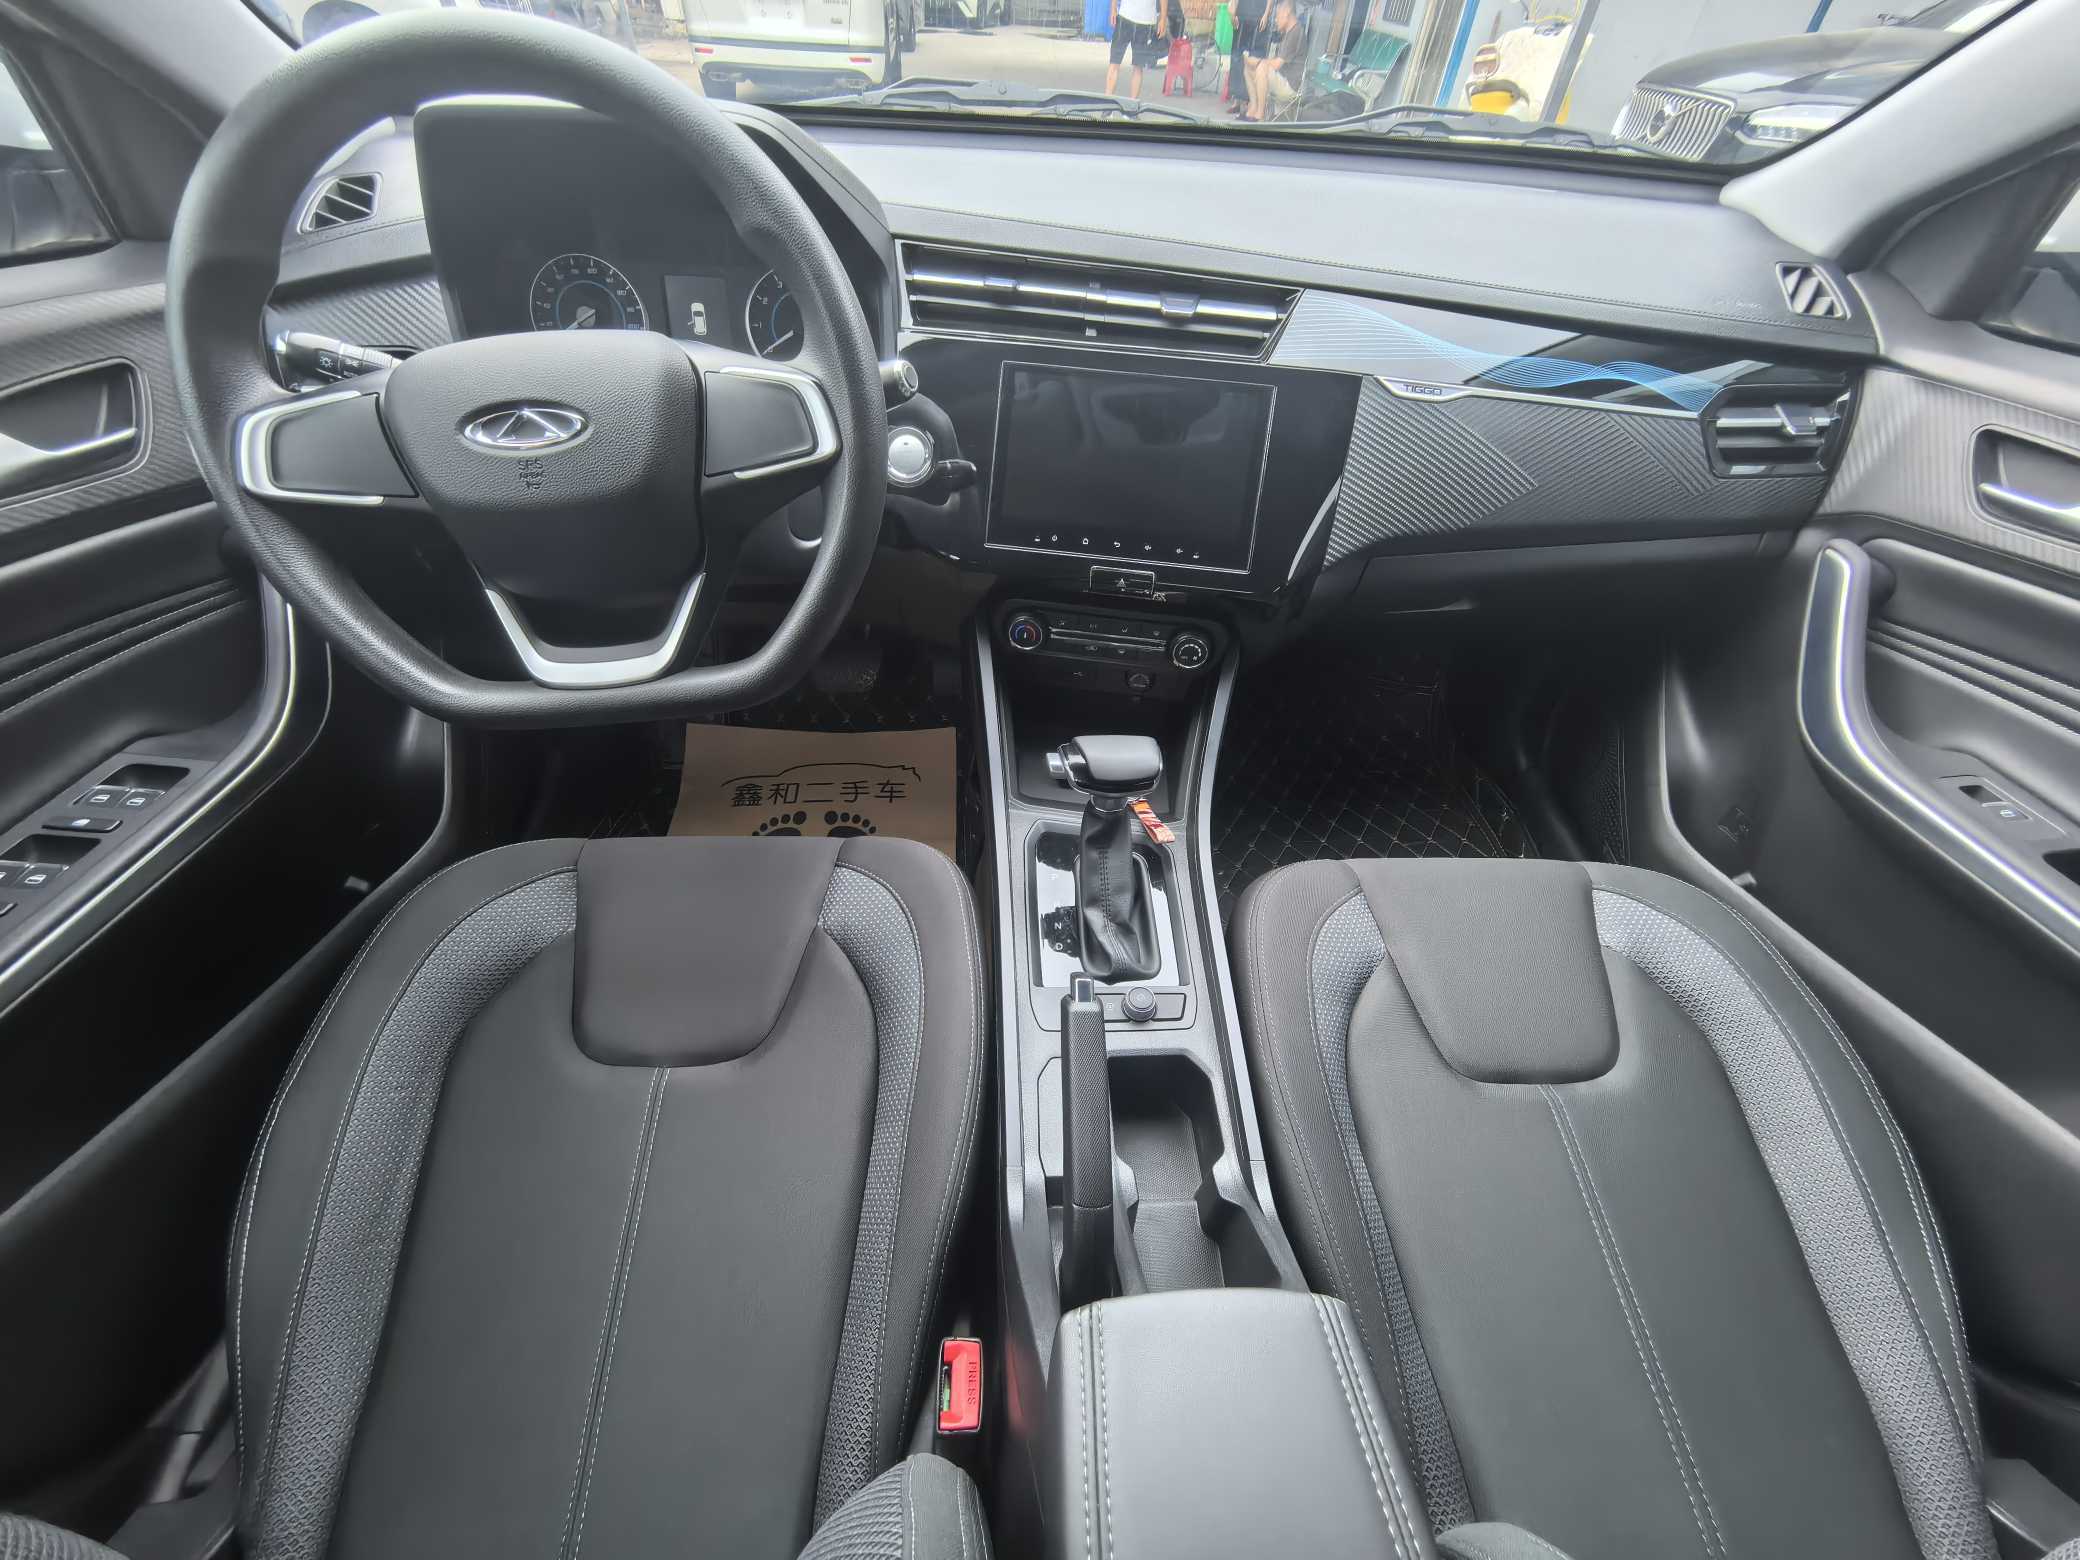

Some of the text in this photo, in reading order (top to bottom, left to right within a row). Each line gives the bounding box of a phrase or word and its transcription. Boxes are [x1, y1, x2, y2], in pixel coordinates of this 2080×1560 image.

[1403, 384, 1442, 396] TIGGO
[730, 779, 908, 808] 鑫和二手车
[1054, 921, 1062, 930] N
[1055, 942, 1064, 951] D
[967, 1360, 978, 1406] PRESS
